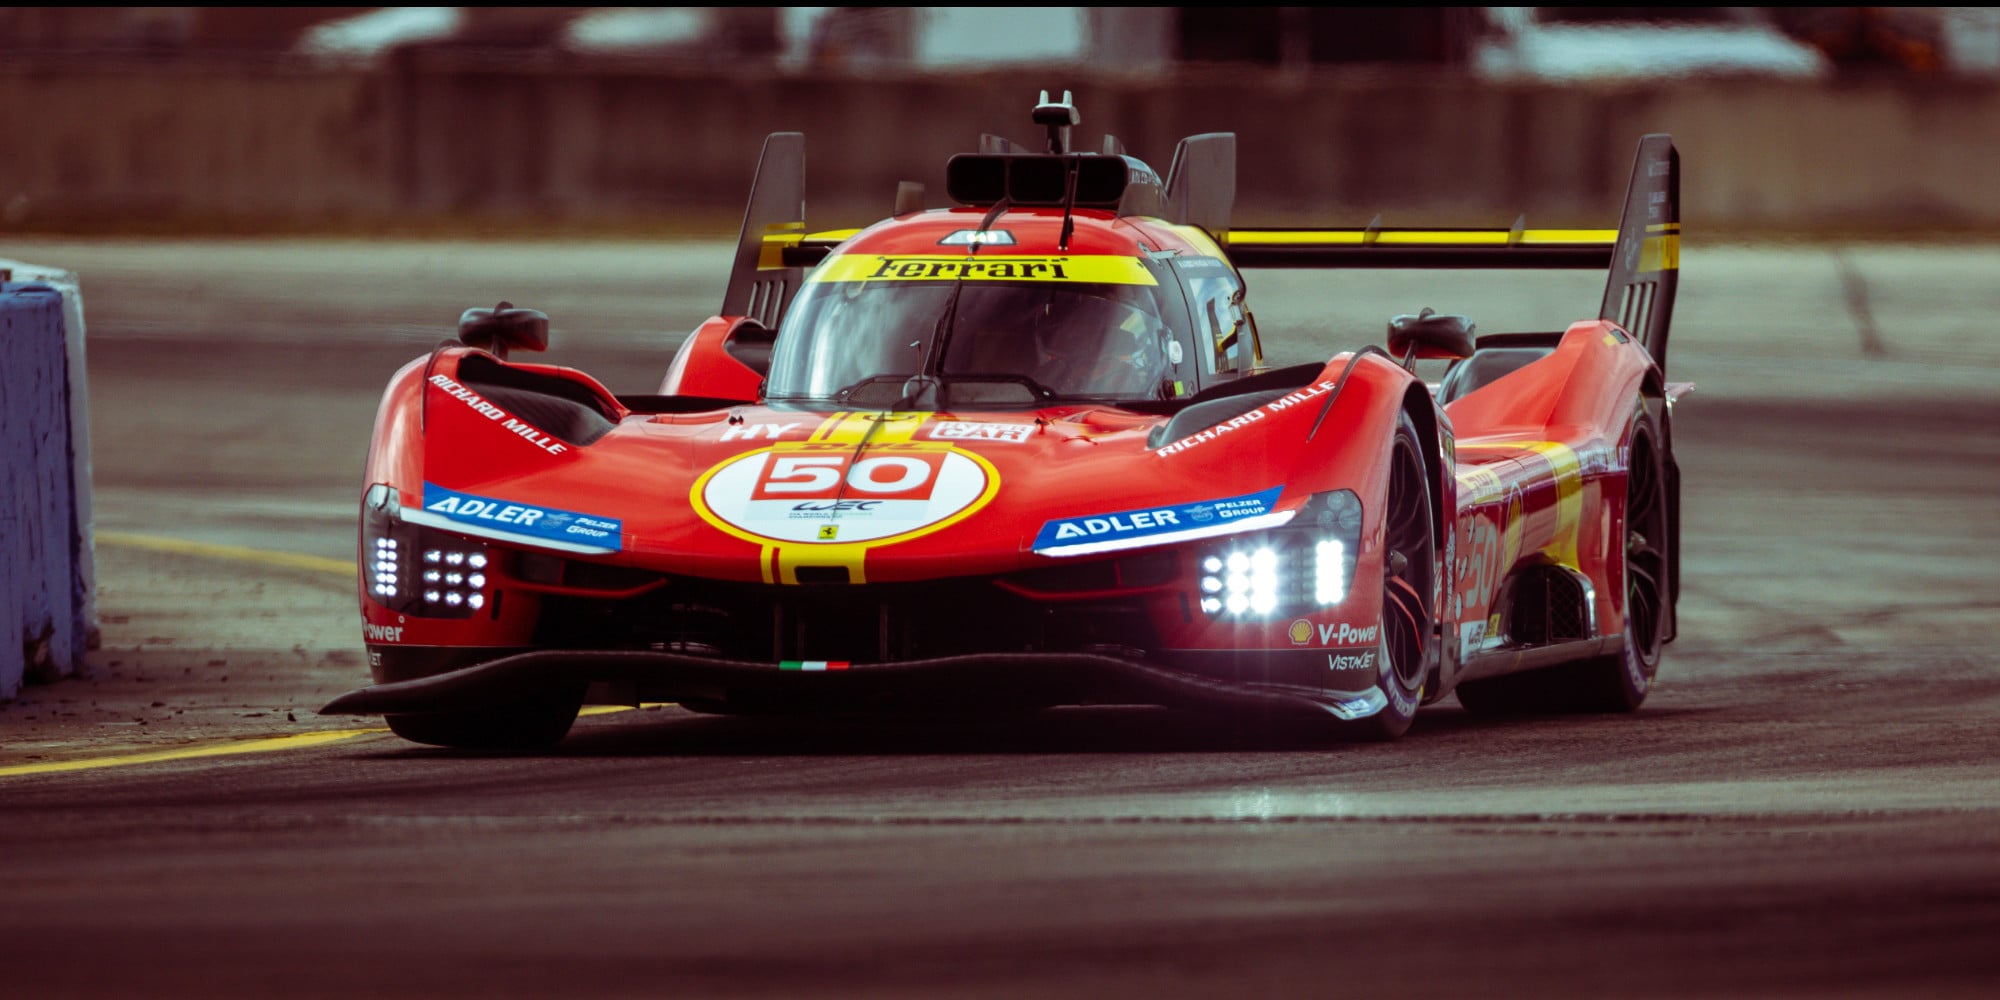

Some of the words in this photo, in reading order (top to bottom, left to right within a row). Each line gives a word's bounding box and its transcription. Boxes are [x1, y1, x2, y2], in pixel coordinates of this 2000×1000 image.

[867, 256, 1069, 279] Ferrari
[429, 374, 505, 421] RICHARD
[502, 418, 567, 455] MILLE
[1157, 410, 1265, 458] RICHARD
[1267, 380, 1336, 413] MILLE
[720, 422, 802, 441] HY
[764, 456, 931, 493] 50
[426, 496, 544, 526] ADLER
[792, 501, 882, 511] WEC
[1214, 500, 1261, 510] PELZER
[1219, 506, 1265, 518] GROUP
[566, 525, 609, 537] GROUP
[574, 517, 618, 530] PELZER
[1055, 510, 1180, 540] ADLER
[1465, 522, 1498, 609] 50
[1318, 623, 1377, 645] V-Power
